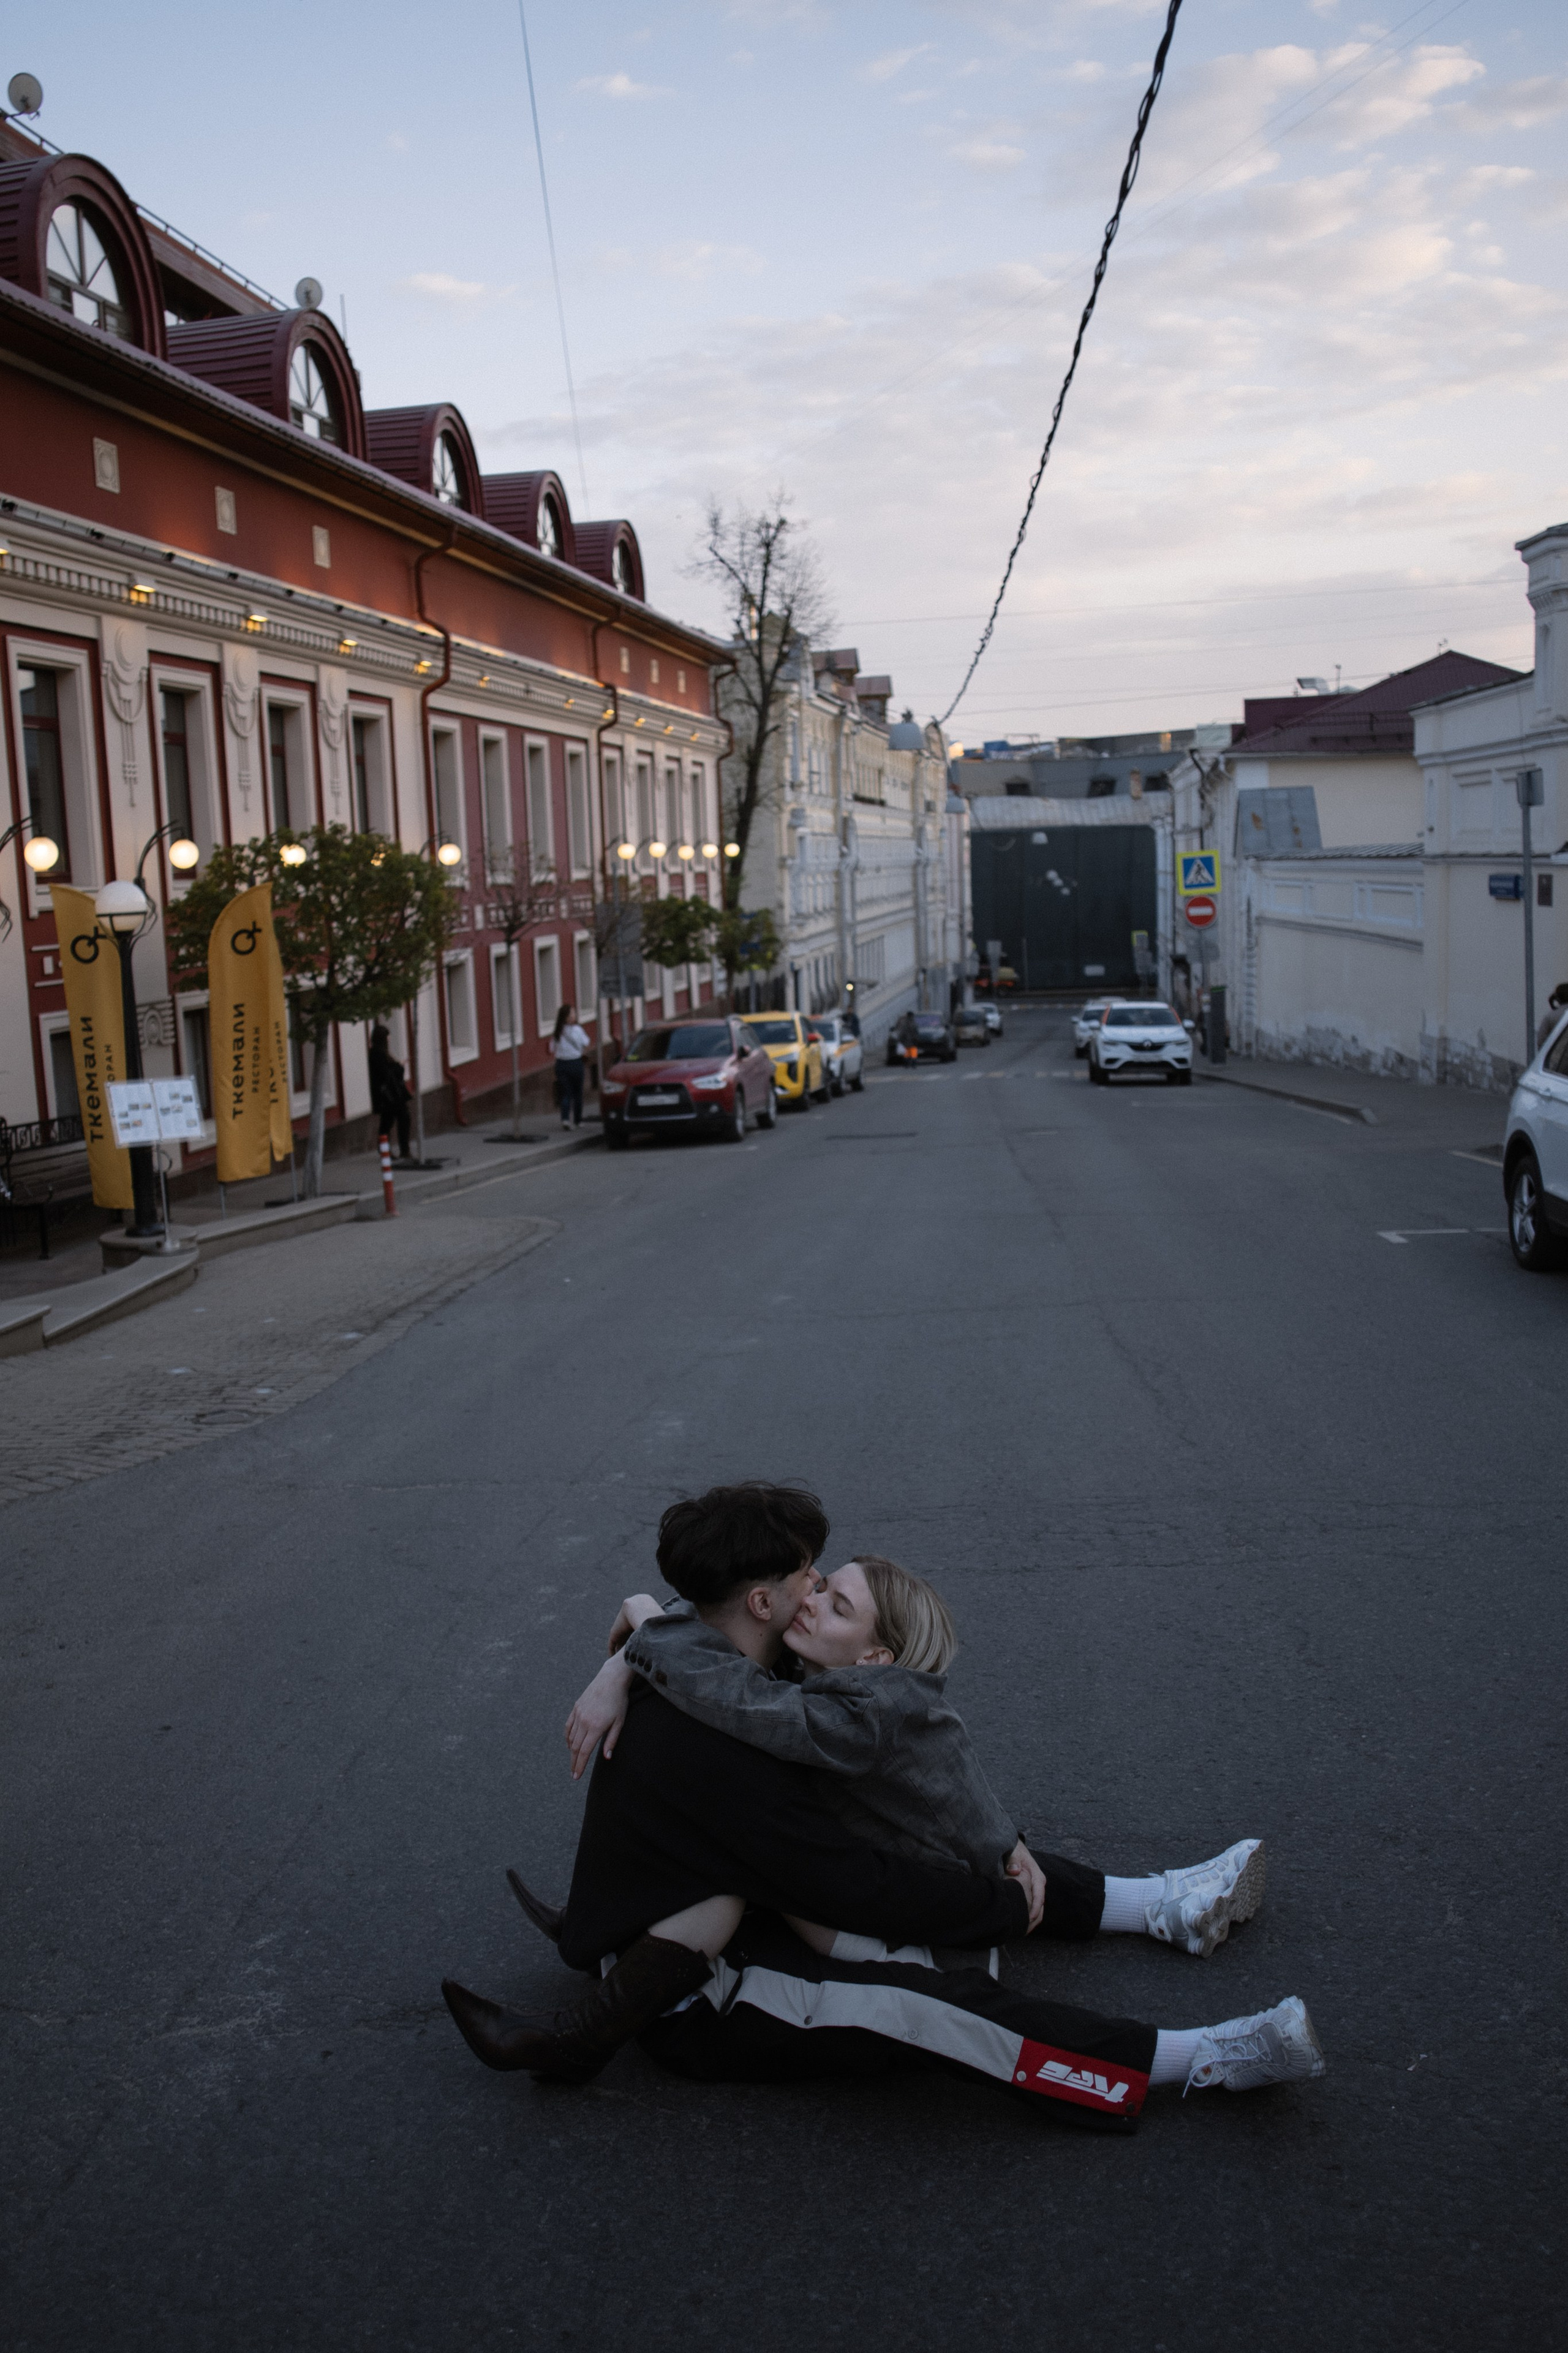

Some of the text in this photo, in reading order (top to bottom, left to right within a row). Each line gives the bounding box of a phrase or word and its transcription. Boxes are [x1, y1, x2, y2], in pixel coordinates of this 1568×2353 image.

[80, 1016, 104, 1144] ткемали
[232, 1003, 244, 1120] ткемали
[252, 1027, 260, 1093] РЕСТОРАН
